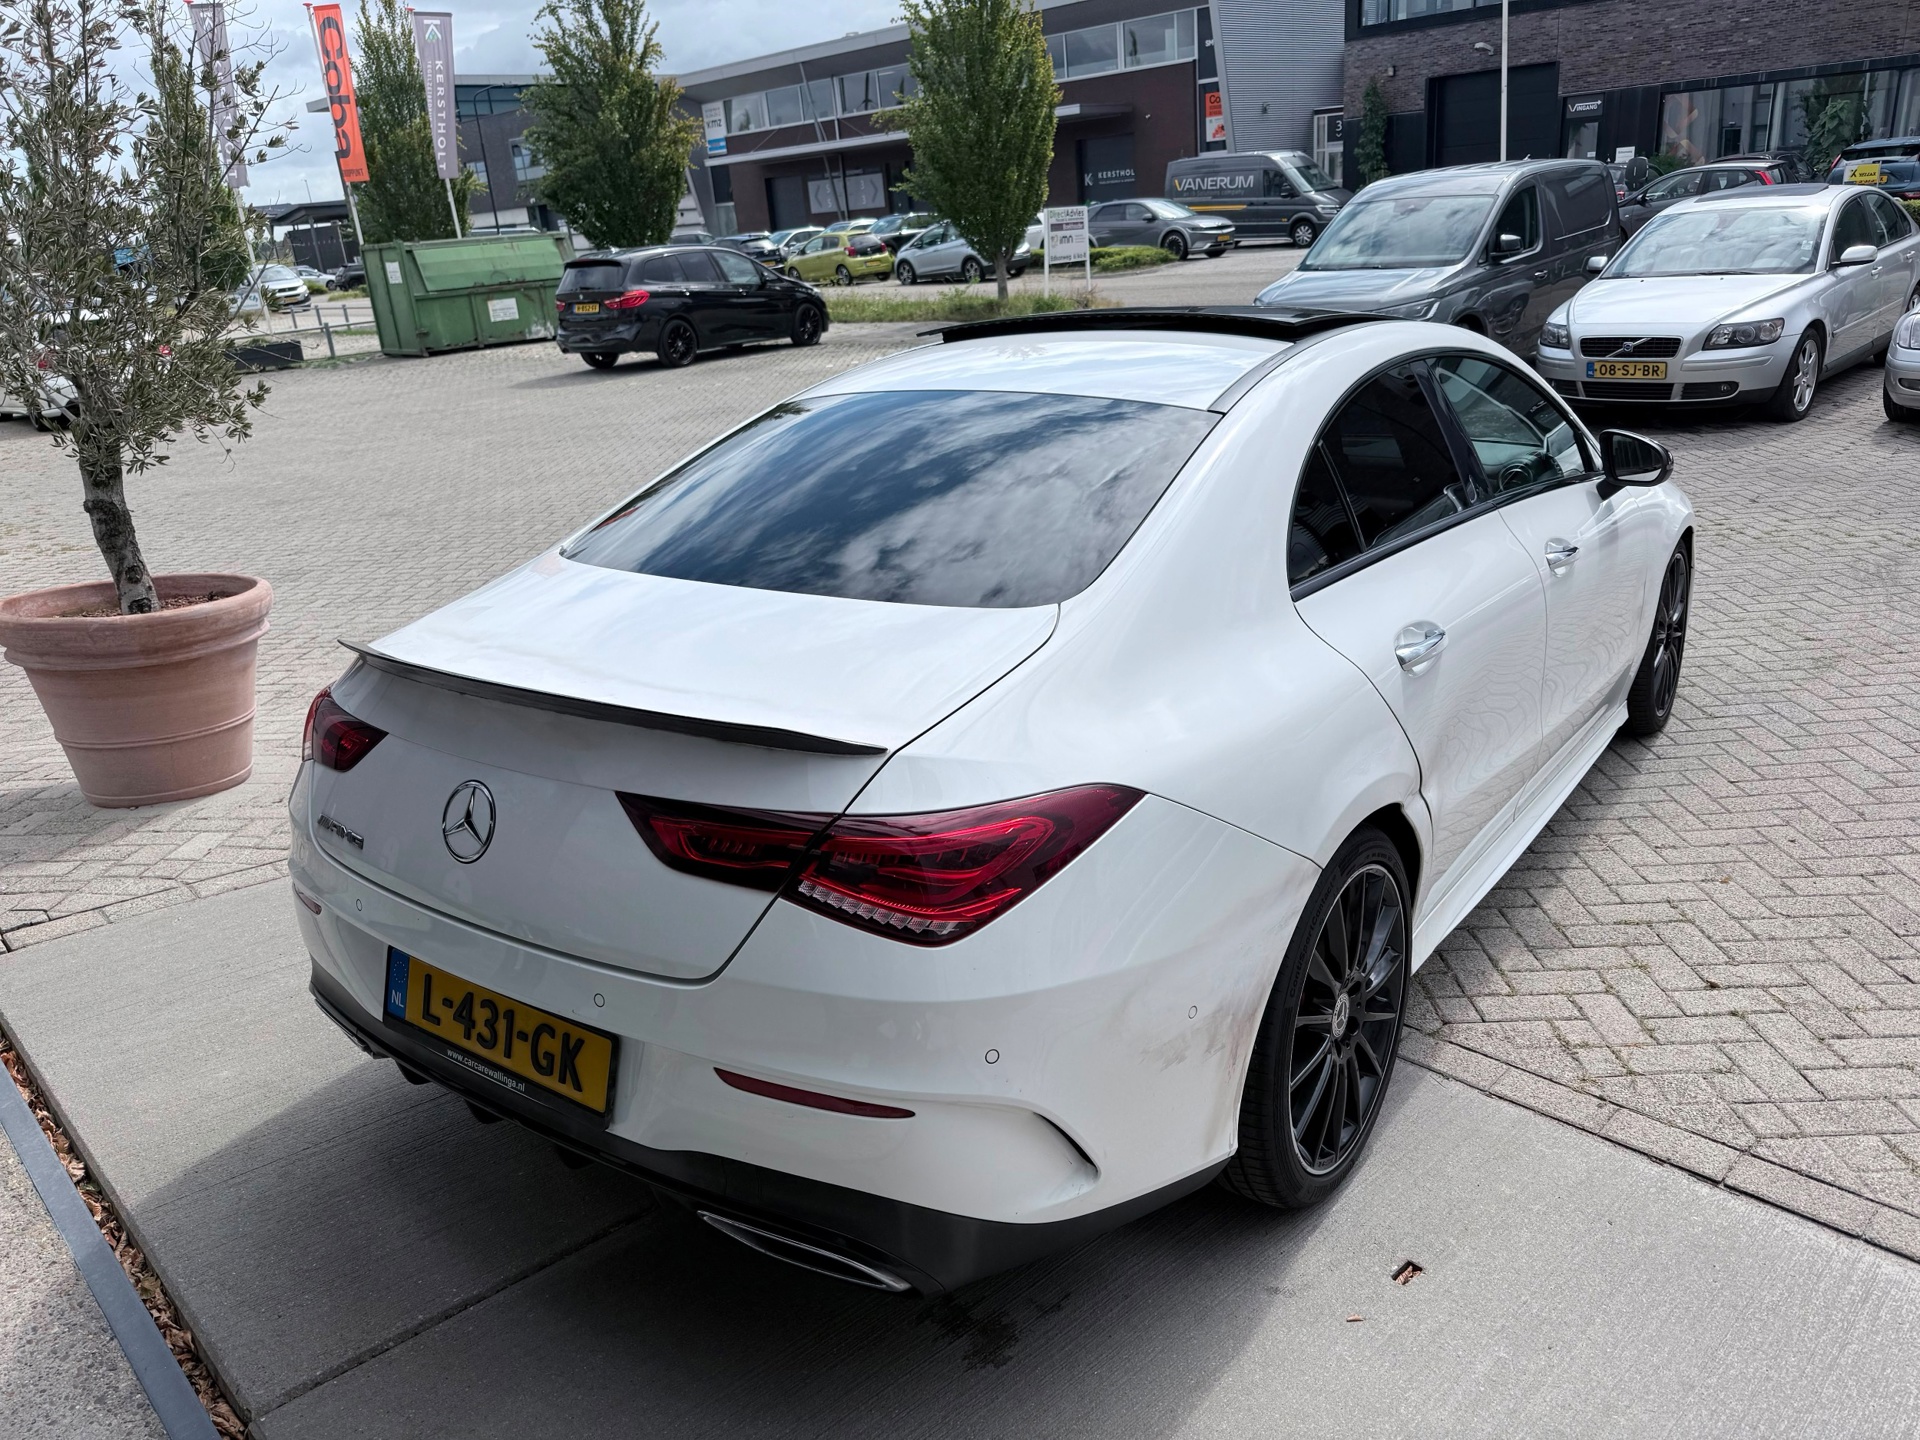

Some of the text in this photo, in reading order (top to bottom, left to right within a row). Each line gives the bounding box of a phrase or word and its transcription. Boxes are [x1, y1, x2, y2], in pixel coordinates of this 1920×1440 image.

[435, 60, 447, 171] KERSTHOLT
[1335, 120, 1342, 131] 3
[1174, 175, 1255, 191] VANERUM
[1599, 364, 1660, 376] 08-SJ-BR
[391, 973, 585, 1093] NL L-431-GK
[447, 1049, 526, 1092] www.carcarewallinga.nl
